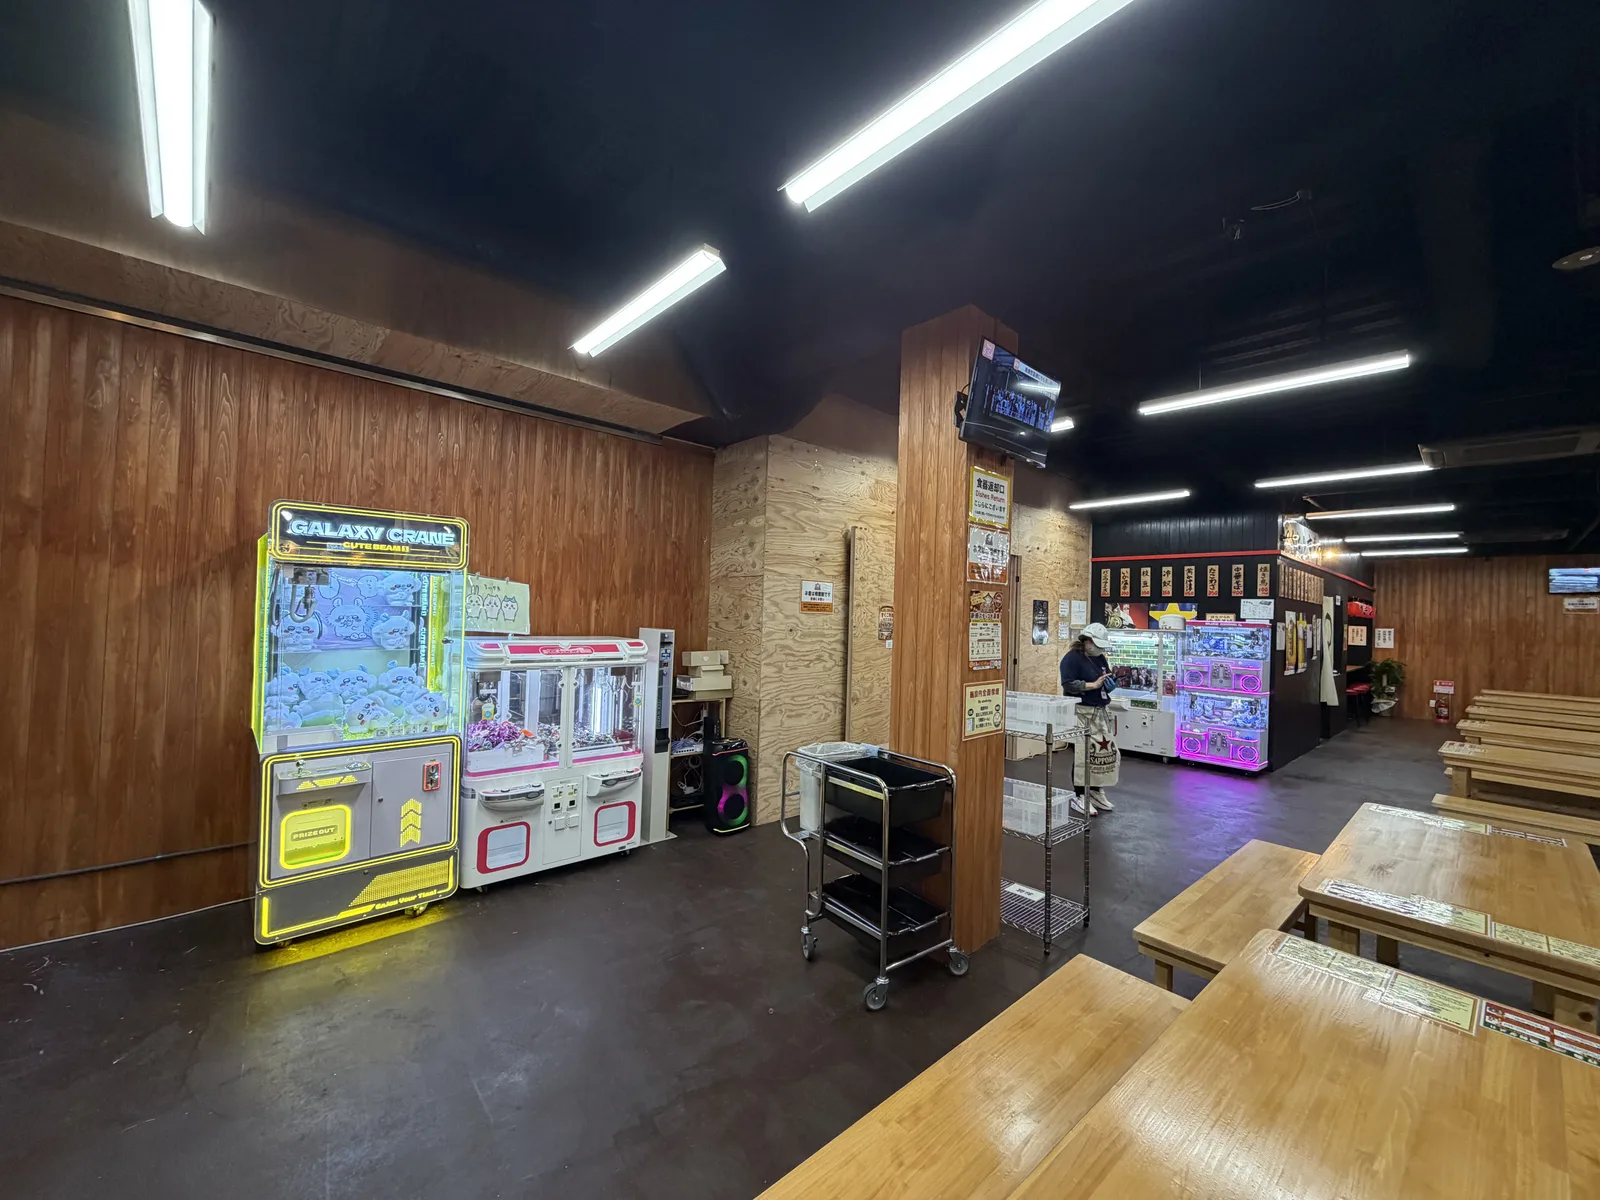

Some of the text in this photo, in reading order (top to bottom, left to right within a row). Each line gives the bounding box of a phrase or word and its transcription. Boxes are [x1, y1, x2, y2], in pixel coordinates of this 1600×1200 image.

[977, 477, 1005, 494] 食器返却口
[976, 490, 1005, 503] Dishes Return
[291, 520, 456, 546] GALAXY CRANE
[343, 541, 373, 550] CUTE
[373, 543, 403, 552] BEAM
[1142, 569, 1149, 588] 枝豆
[1163, 569, 1171, 588] 冷奴
[1233, 566, 1242, 590] 中華そば
